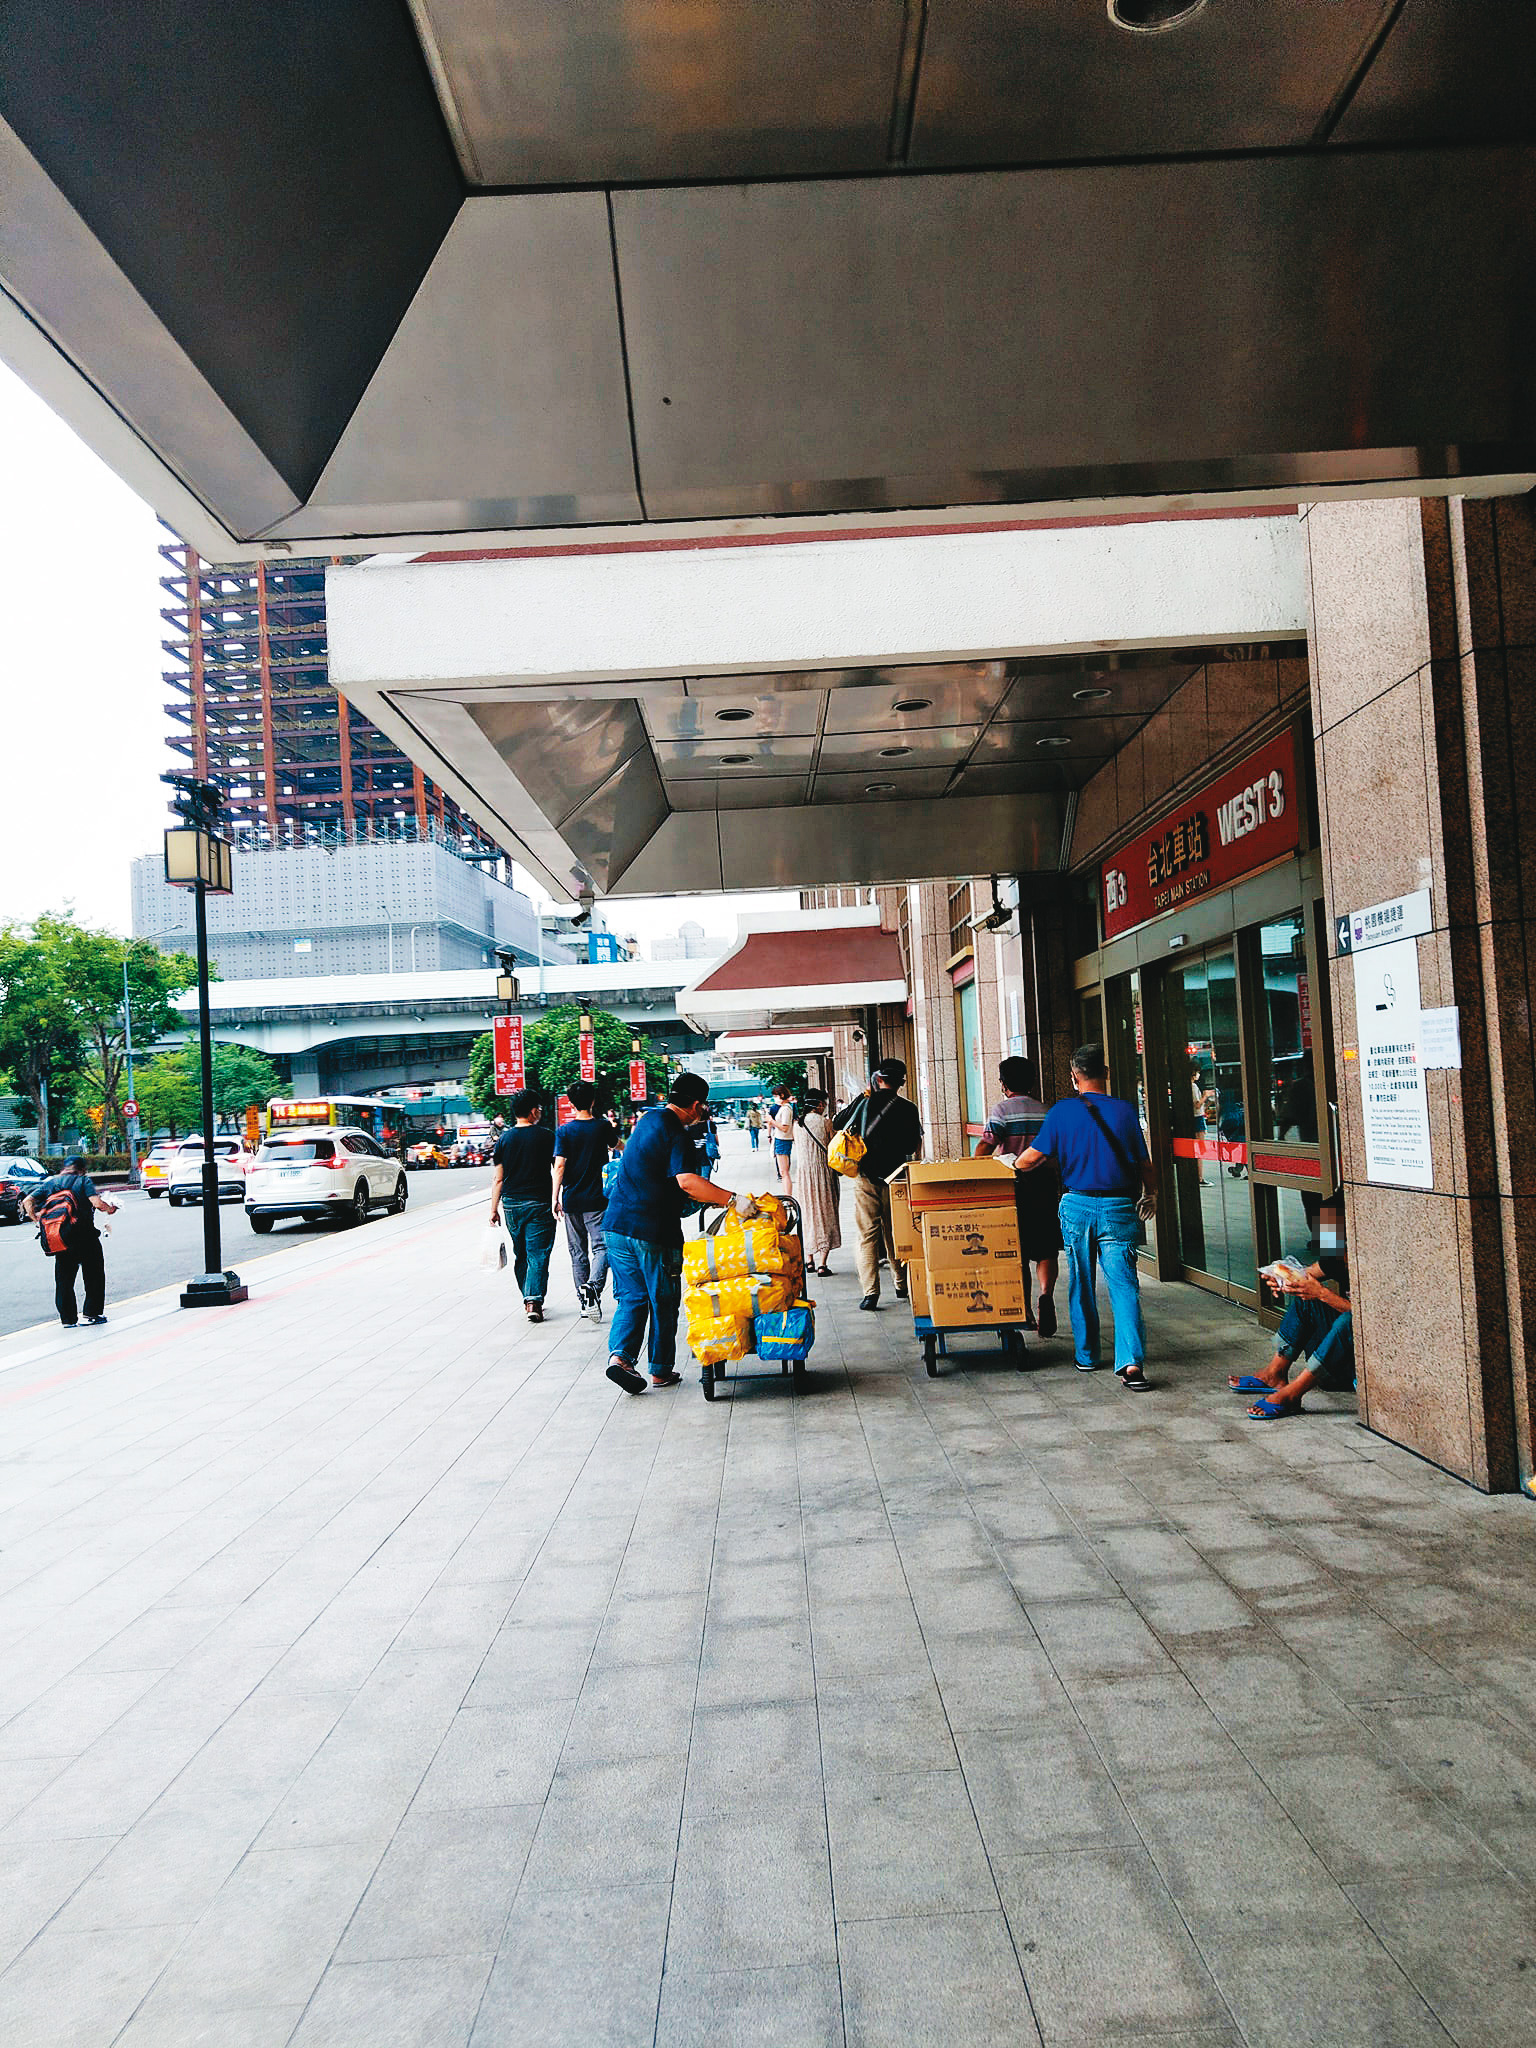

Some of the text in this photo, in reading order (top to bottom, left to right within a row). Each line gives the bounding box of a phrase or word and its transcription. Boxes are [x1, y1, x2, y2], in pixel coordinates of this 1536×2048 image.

[1217, 770, 1285, 846] WEST 3
[1148, 813, 1203, 887] 台北車站
[1154, 871, 1208, 909] TAIPEI MAIN STATION
[509, 1018, 521, 1071] 禁止計程車
[947, 1223, 981, 1233] 大燕麥片
